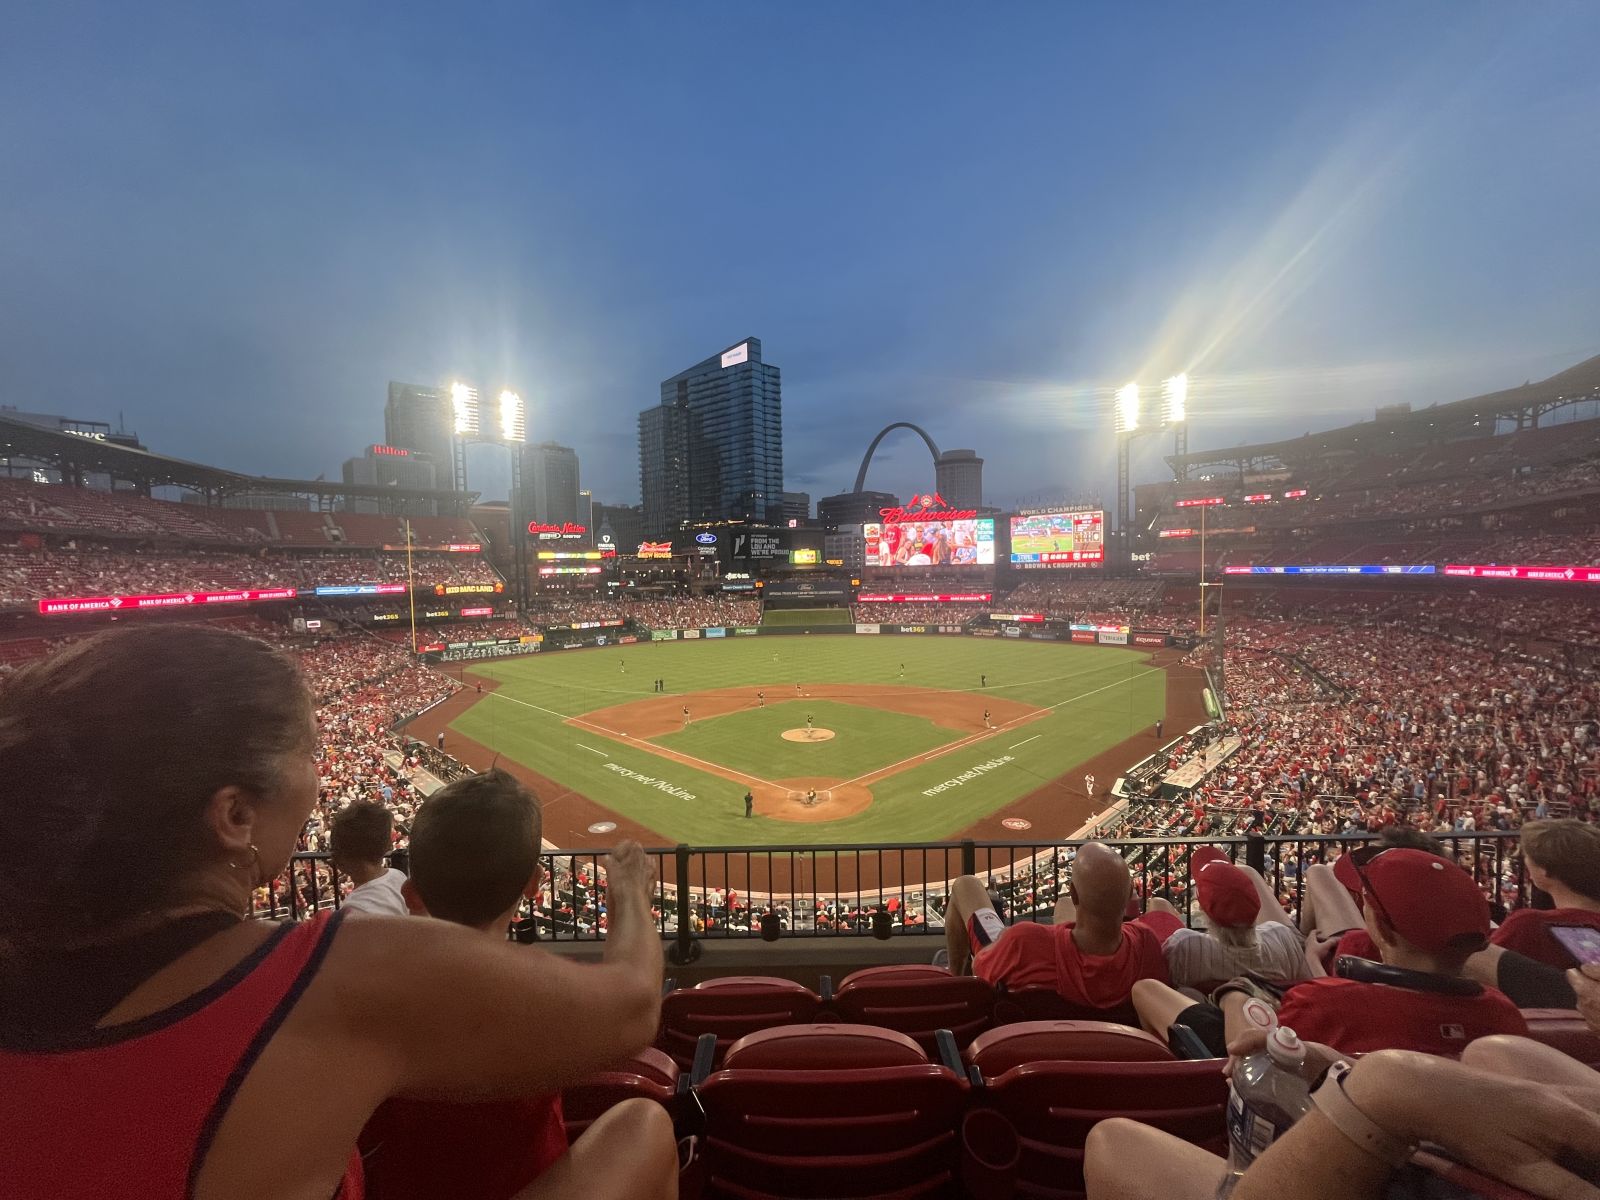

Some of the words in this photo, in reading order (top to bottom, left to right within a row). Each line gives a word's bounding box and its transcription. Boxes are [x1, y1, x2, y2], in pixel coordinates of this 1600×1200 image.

[374, 445, 408, 456] Hilton
[1048, 504, 1094, 514] CHAMPIONS
[879, 507, 977, 524] Budweiser
[528, 521, 560, 534] Cardinals
[560, 522, 586, 534] Nation
[446, 586, 460, 594] BIG
[79, 601, 110, 609] AMERICA
[1135, 636, 1162, 644] EQUIFAX
[921, 755, 1015, 797] mercy.net/NoLine
[602, 763, 697, 801] mercy.net/NoLine
